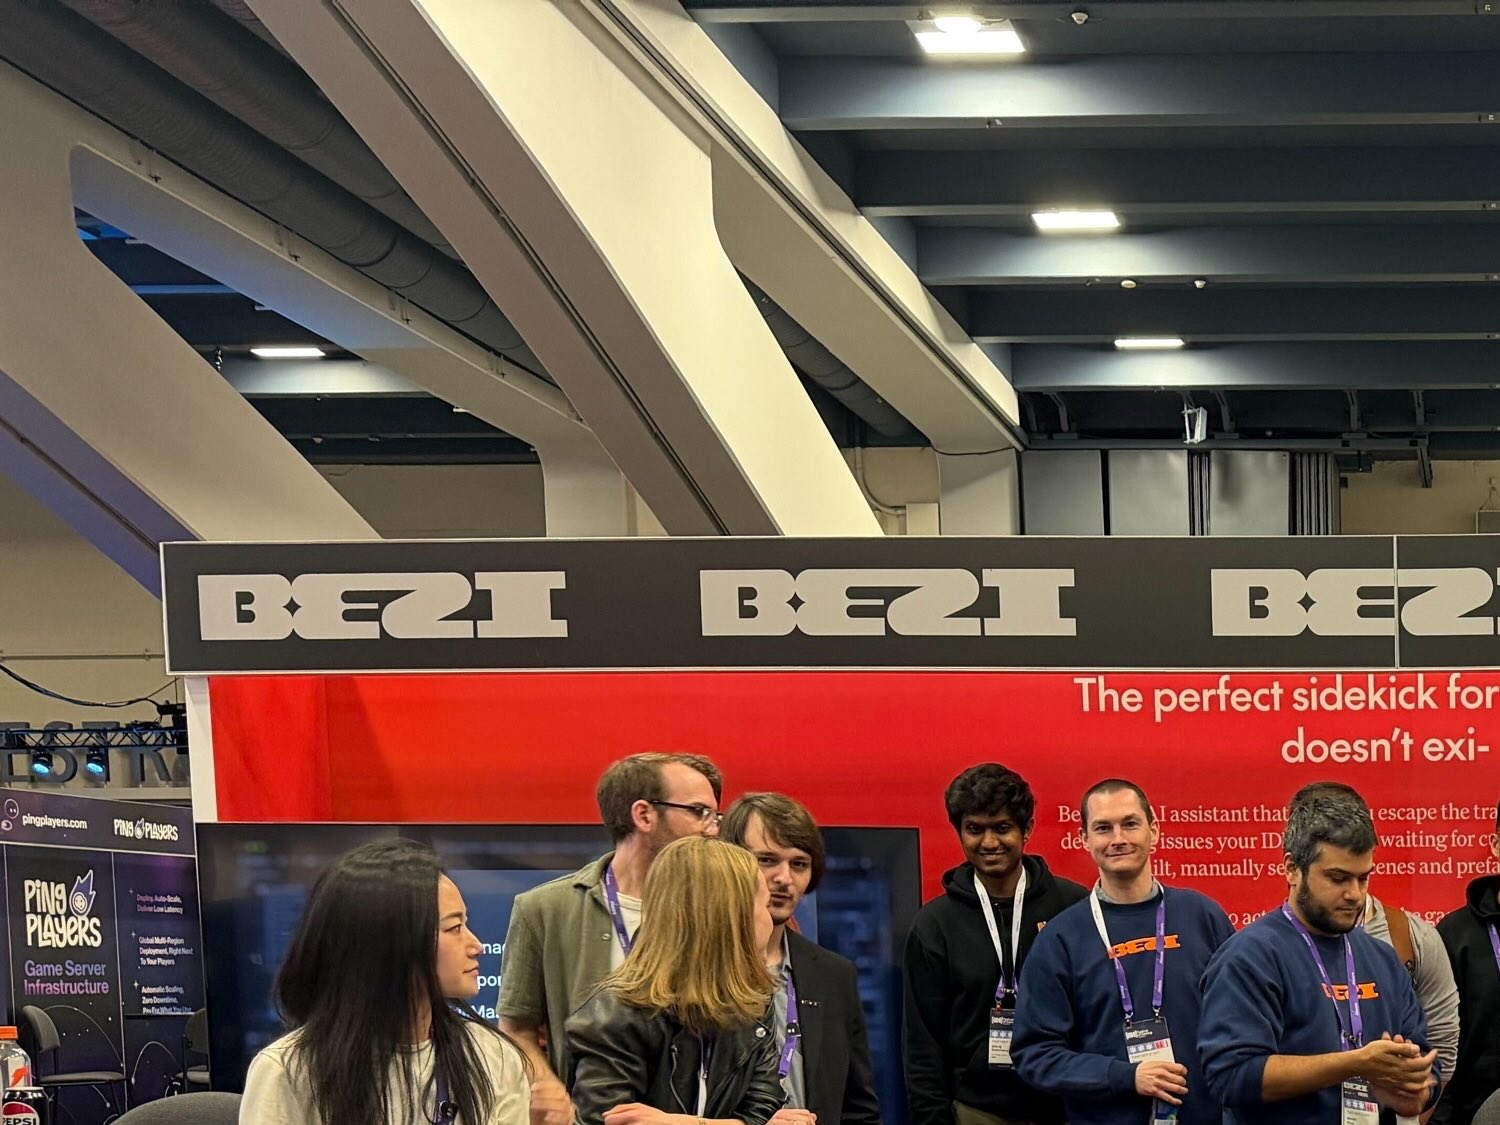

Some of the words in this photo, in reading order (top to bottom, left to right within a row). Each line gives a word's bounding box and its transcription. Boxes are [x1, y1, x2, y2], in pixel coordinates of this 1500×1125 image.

[198, 571, 568, 640] BEZI
[700, 569, 1076, 636] BEZI
[1074, 676, 1143, 712] The
[1154, 674, 1284, 723] perfect
[1292, 674, 1438, 712] sidekick
[1446, 672, 1500, 710] for
[1281, 726, 1413, 764] doesn't
[1422, 728, 1491, 763] exi-
[22, 813, 88, 829] pingplayers.com
[1058, 805, 1080, 822] Be
[1170, 804, 1249, 822] assistant
[1253, 804, 1289, 822] that
[1378, 806, 1438, 825] escape
[1441, 802, 1470, 820] the
[1473, 804, 1498, 820] tra
[1061, 832, 1083, 849] de
[1161, 832, 1212, 849] issues
[1215, 835, 1258, 853] your
[1380, 830, 1449, 852] waiting
[1451, 829, 1475, 847] for
[1153, 859, 1177, 879] ilt,
[1181, 857, 1266, 880] manually
[1369, 861, 1415, 875] cenes
[1420, 857, 1453, 874] and
[1456, 856, 1500, 878] prefa
[24, 960, 64, 977] Game
[65, 960, 106, 976] Server
[24, 979, 110, 996] Infrastructure
[3, 1117, 37, 1125] EPSI
